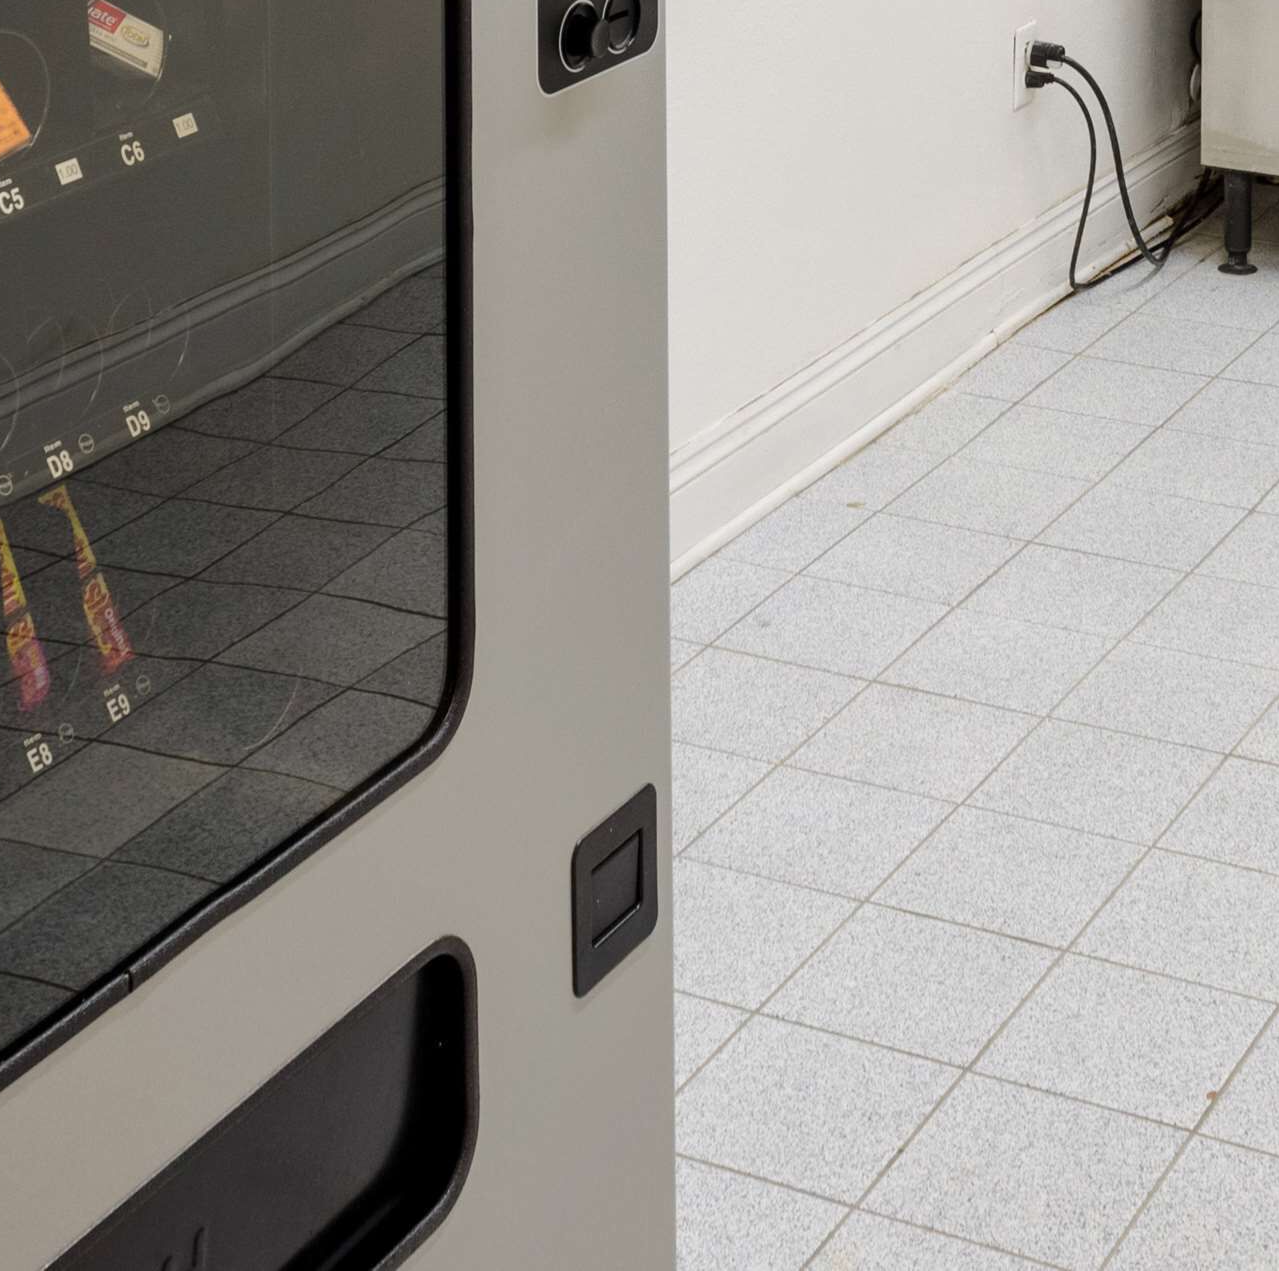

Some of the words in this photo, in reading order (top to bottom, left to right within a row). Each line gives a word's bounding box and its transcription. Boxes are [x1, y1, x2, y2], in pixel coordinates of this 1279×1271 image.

[121, 141, 145, 166] C6
[59, 163, 79, 178] 1.00
[126, 410, 151, 438] D9
[46, 450, 73, 479] D8
[106, 694, 131, 723] E9
[26, 743, 53, 773] E8
